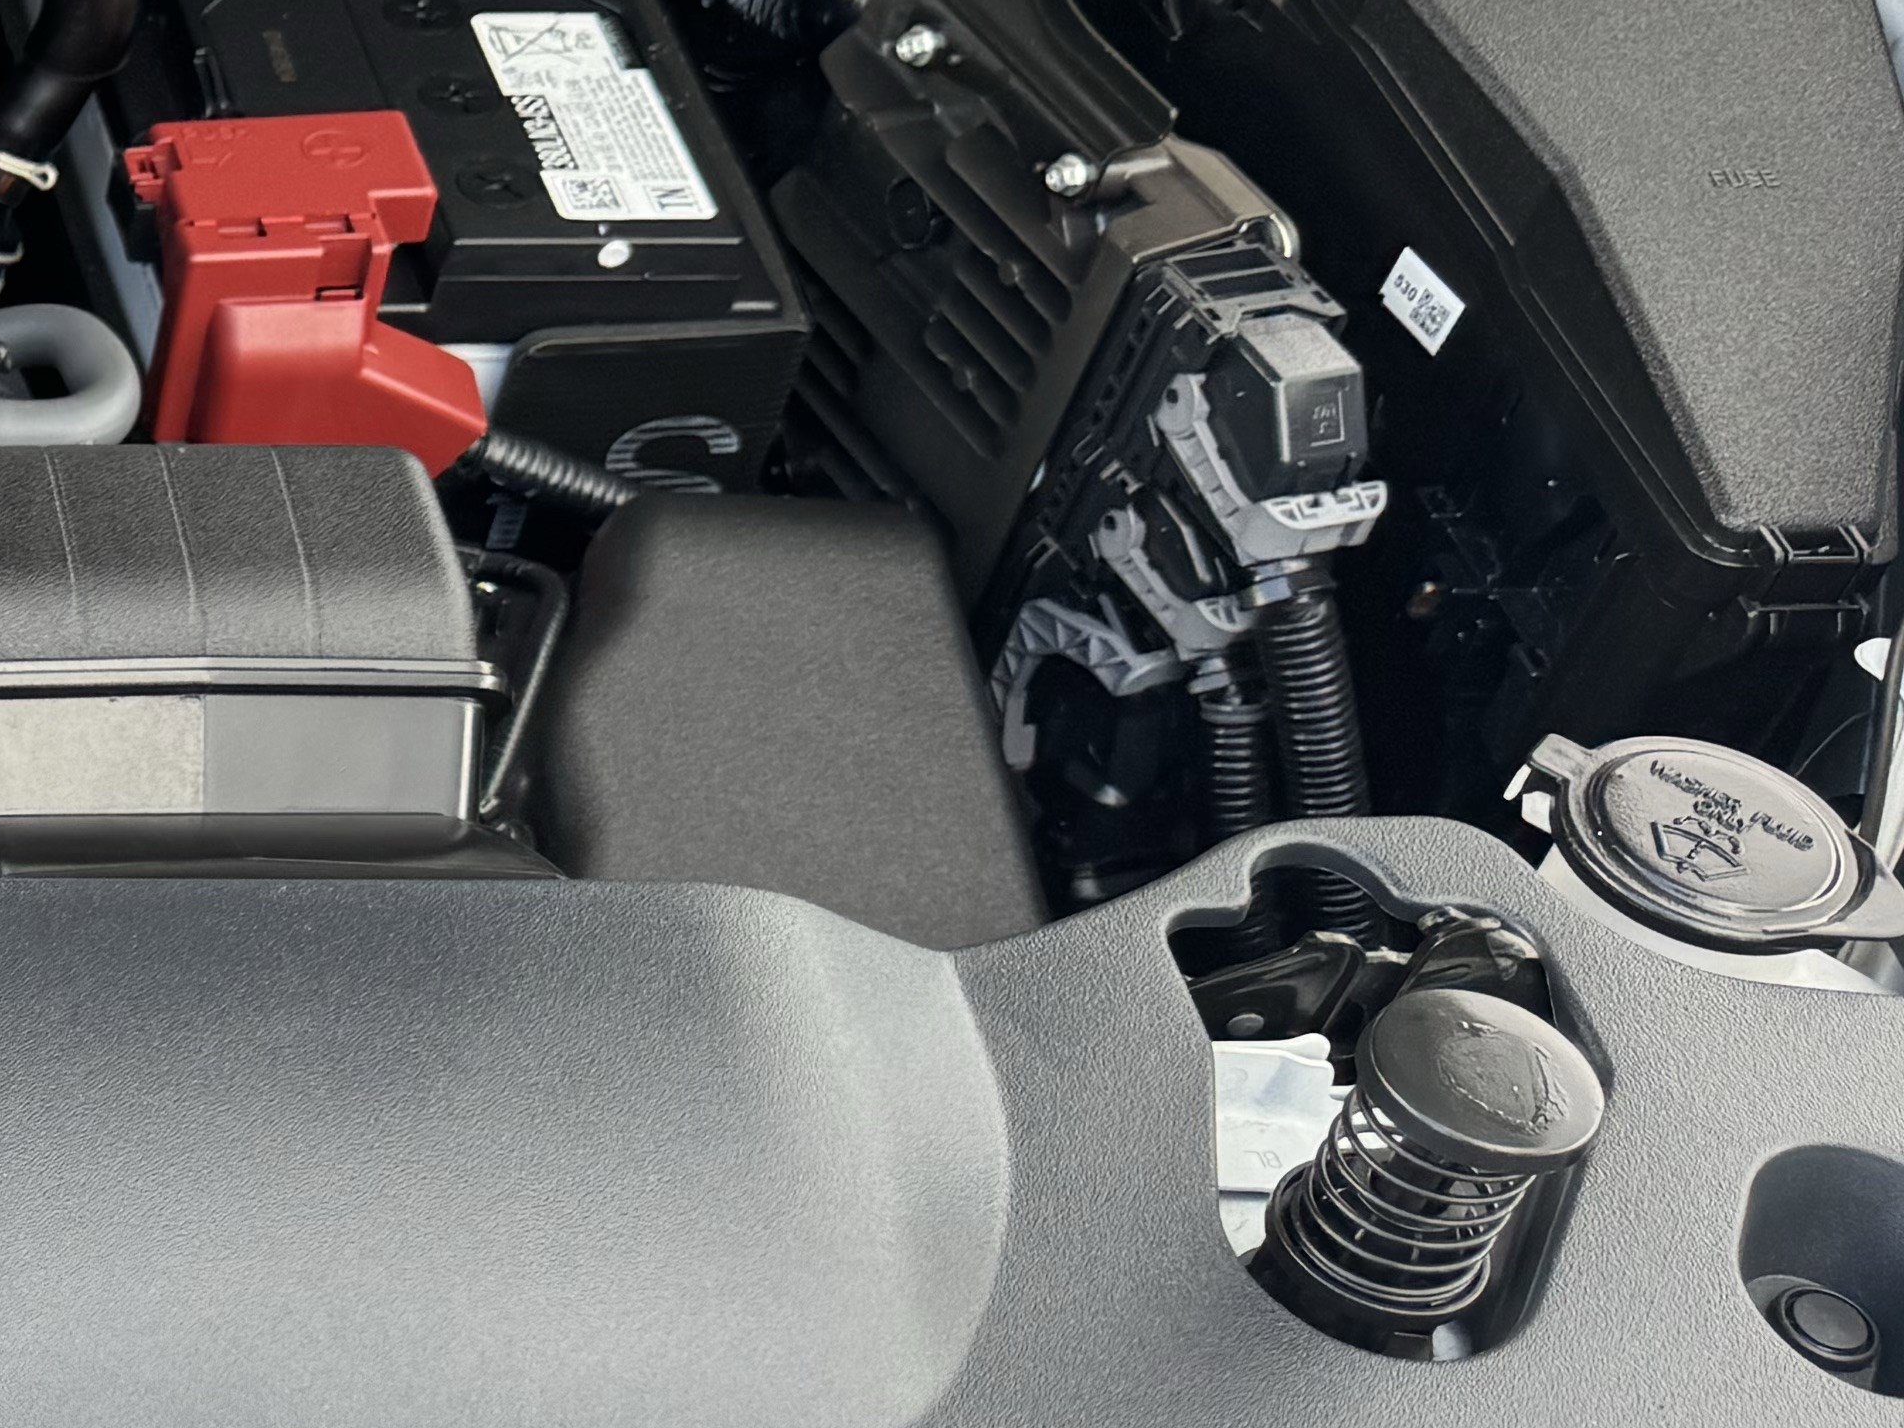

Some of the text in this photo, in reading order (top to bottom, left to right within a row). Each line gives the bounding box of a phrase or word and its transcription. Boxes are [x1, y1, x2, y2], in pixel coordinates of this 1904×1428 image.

[1708, 169, 1781, 188] FUSE
[1650, 759, 1814, 851] WASHER FLUID
[1693, 801, 1744, 834] ONLY
